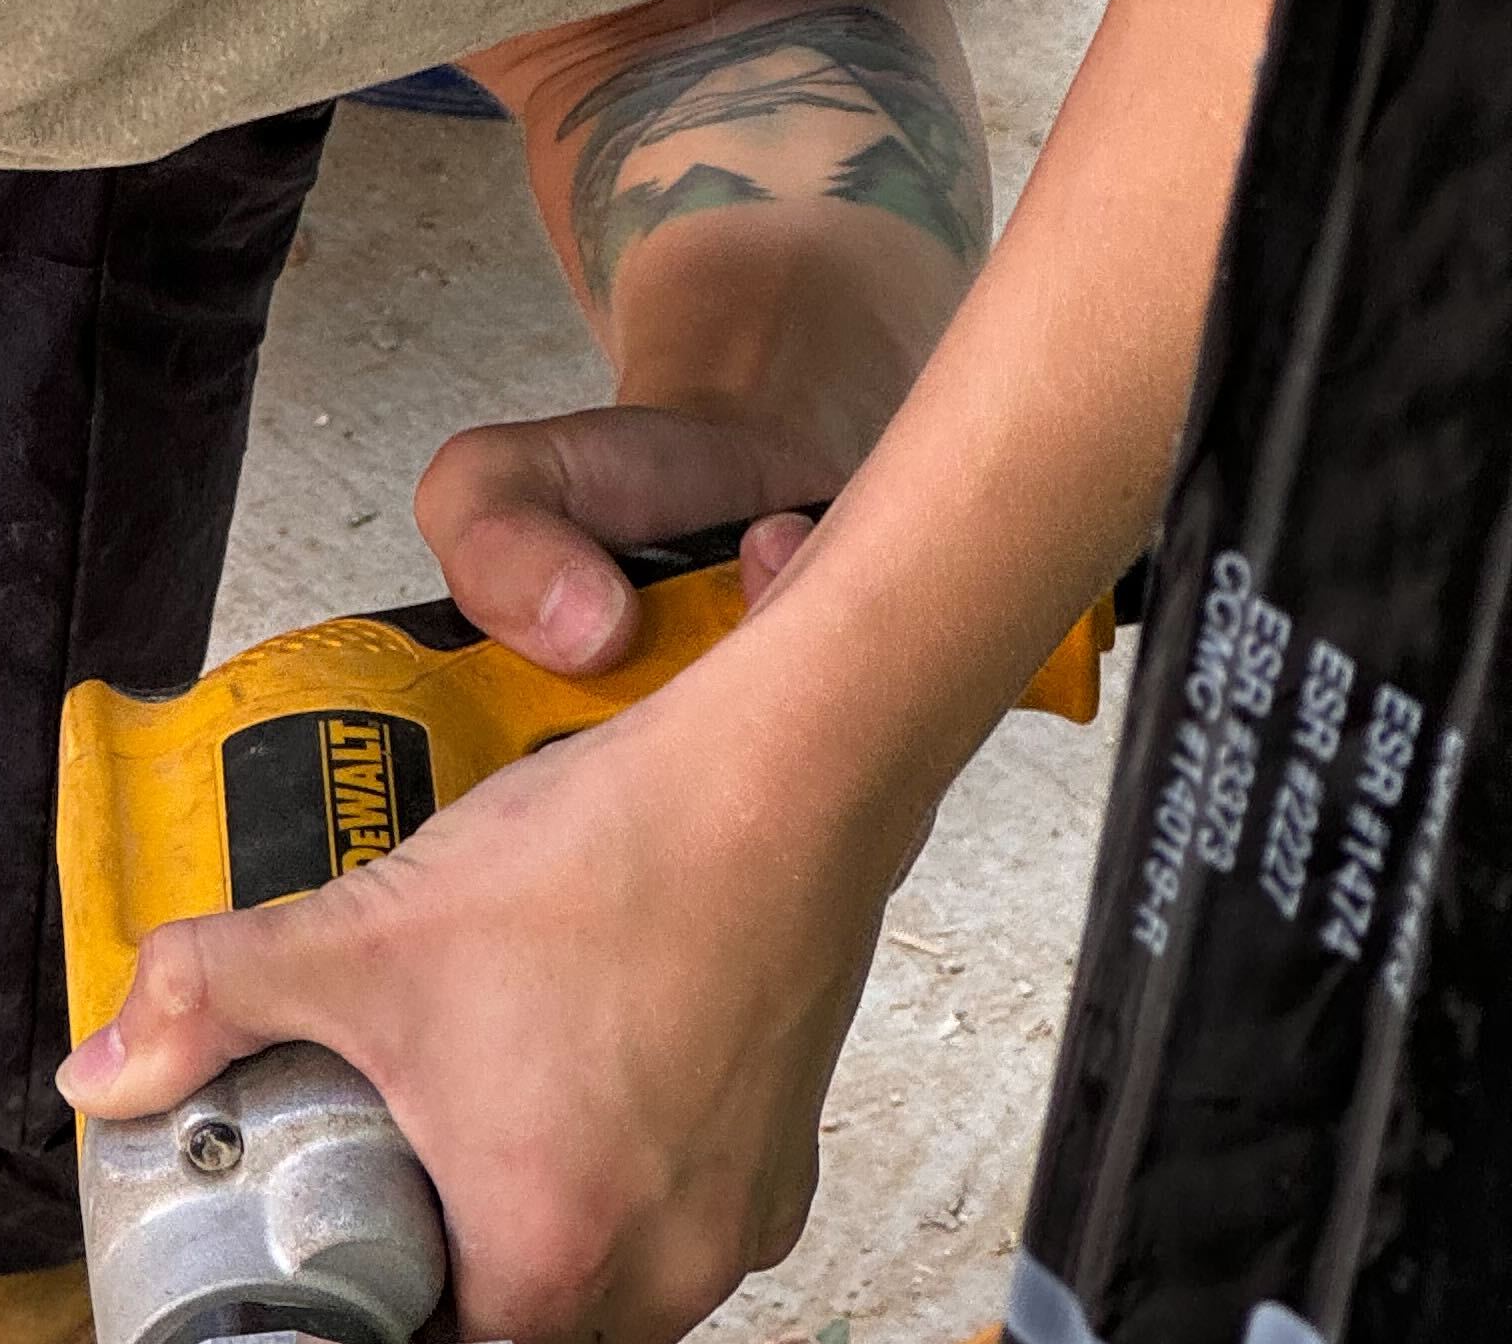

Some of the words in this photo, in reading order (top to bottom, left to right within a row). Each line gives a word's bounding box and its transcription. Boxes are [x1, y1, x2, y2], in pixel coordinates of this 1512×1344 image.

[1189, 550, 1252, 723] CCMC
[1231, 596, 1292, 718] ESR
[1292, 639, 1357, 762] ESR
[1356, 682, 1423, 805] ESR
[1133, 719, 1211, 957] #14019-R
[1259, 758, 1326, 921] #2227
[1319, 805, 1391, 960] #1474
